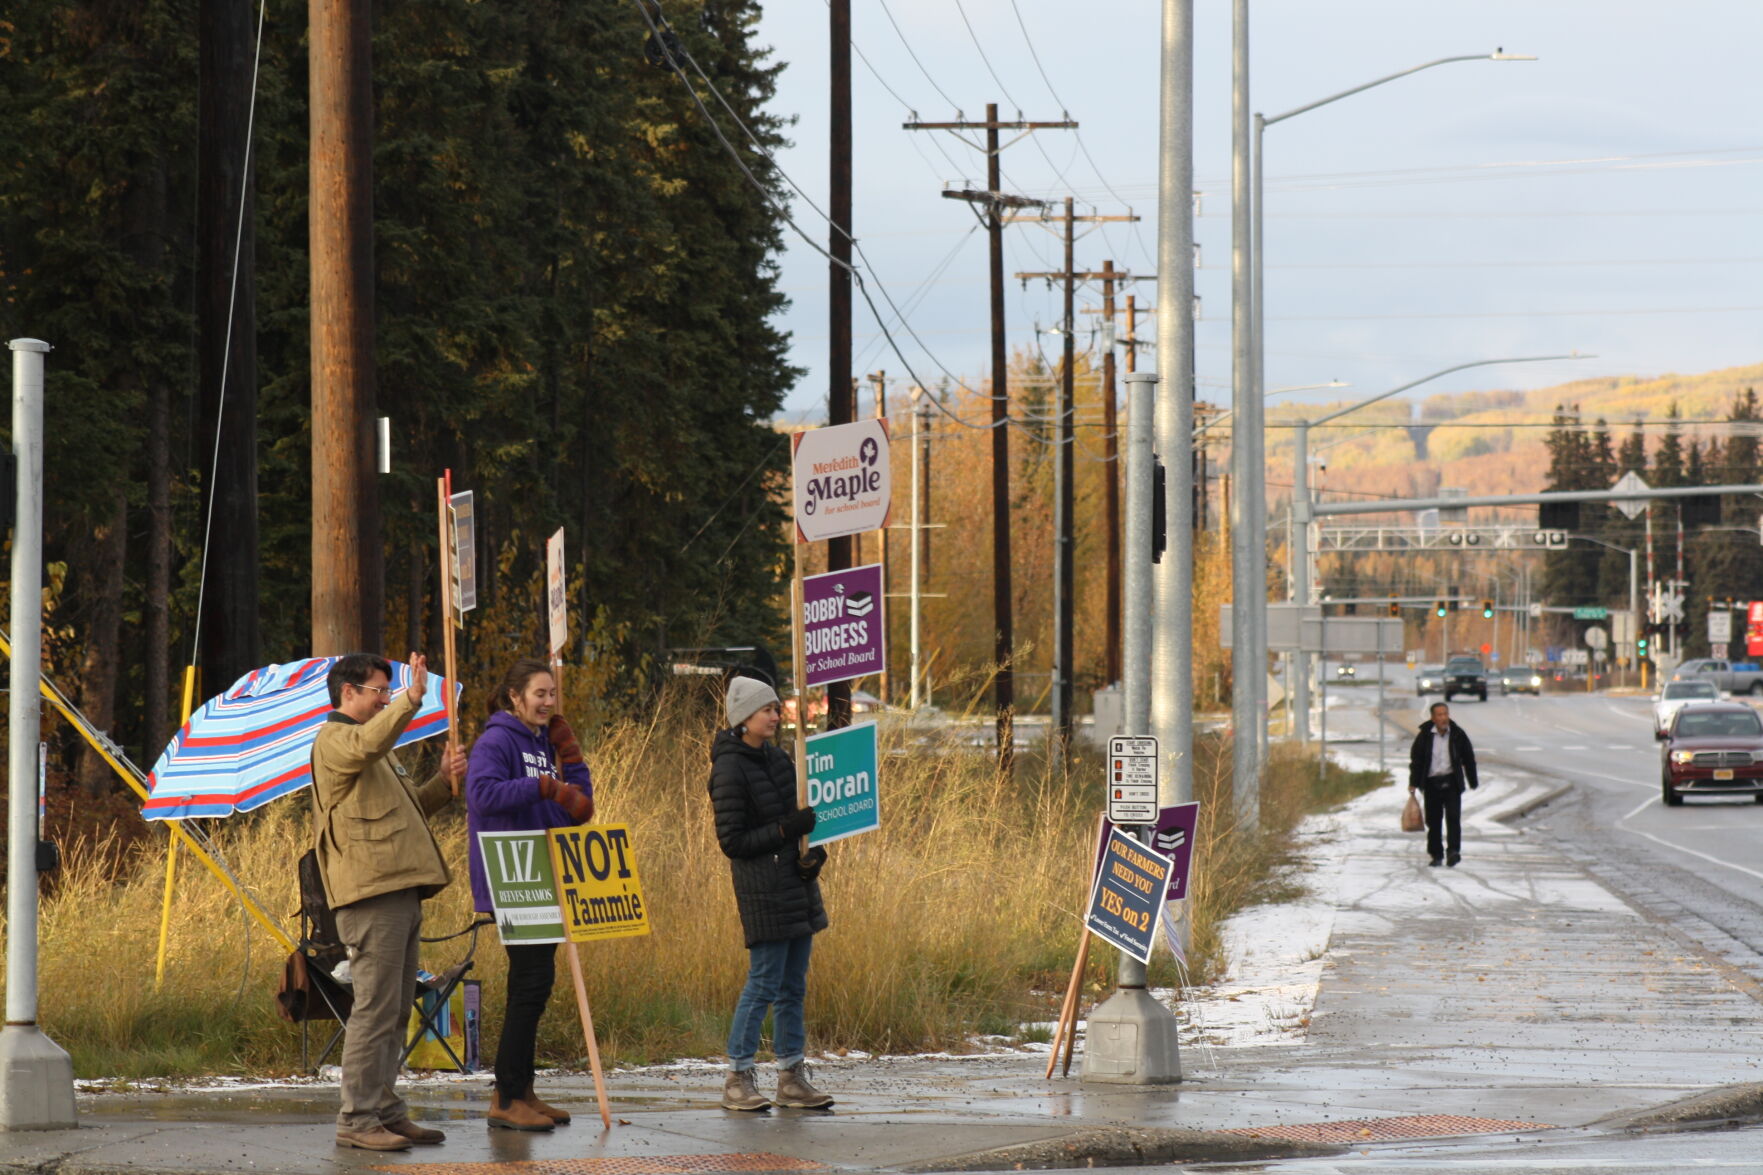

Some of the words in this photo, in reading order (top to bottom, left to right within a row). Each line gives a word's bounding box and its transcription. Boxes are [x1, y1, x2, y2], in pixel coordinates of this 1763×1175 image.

[812, 456, 859, 475] Meredith
[804, 466, 880, 516] Maple
[804, 595, 845, 625] BOBBY
[805, 620, 868, 656] BURGESS
[818, 656, 846, 672] School
[848, 648, 875, 665] Board
[806, 752, 834, 776] Tim
[808, 770, 869, 808] Doran
[818, 808, 847, 823] SCHOOL
[848, 798, 874, 815] BOARD
[494, 840, 542, 883] LIZ
[556, 829, 632, 884] NOT
[1111, 840, 1128, 860] OUR
[1128, 848, 1166, 880] FARMERS
[1112, 860, 1134, 884] NEED
[1134, 874, 1154, 894] YOU
[498, 888, 552, 903] REEVES-RAMOS
[566, 884, 644, 927] Tammie
[1100, 886, 1124, 916] YES
[1122, 907, 1138, 928] on
[1138, 912, 1150, 932] 2
